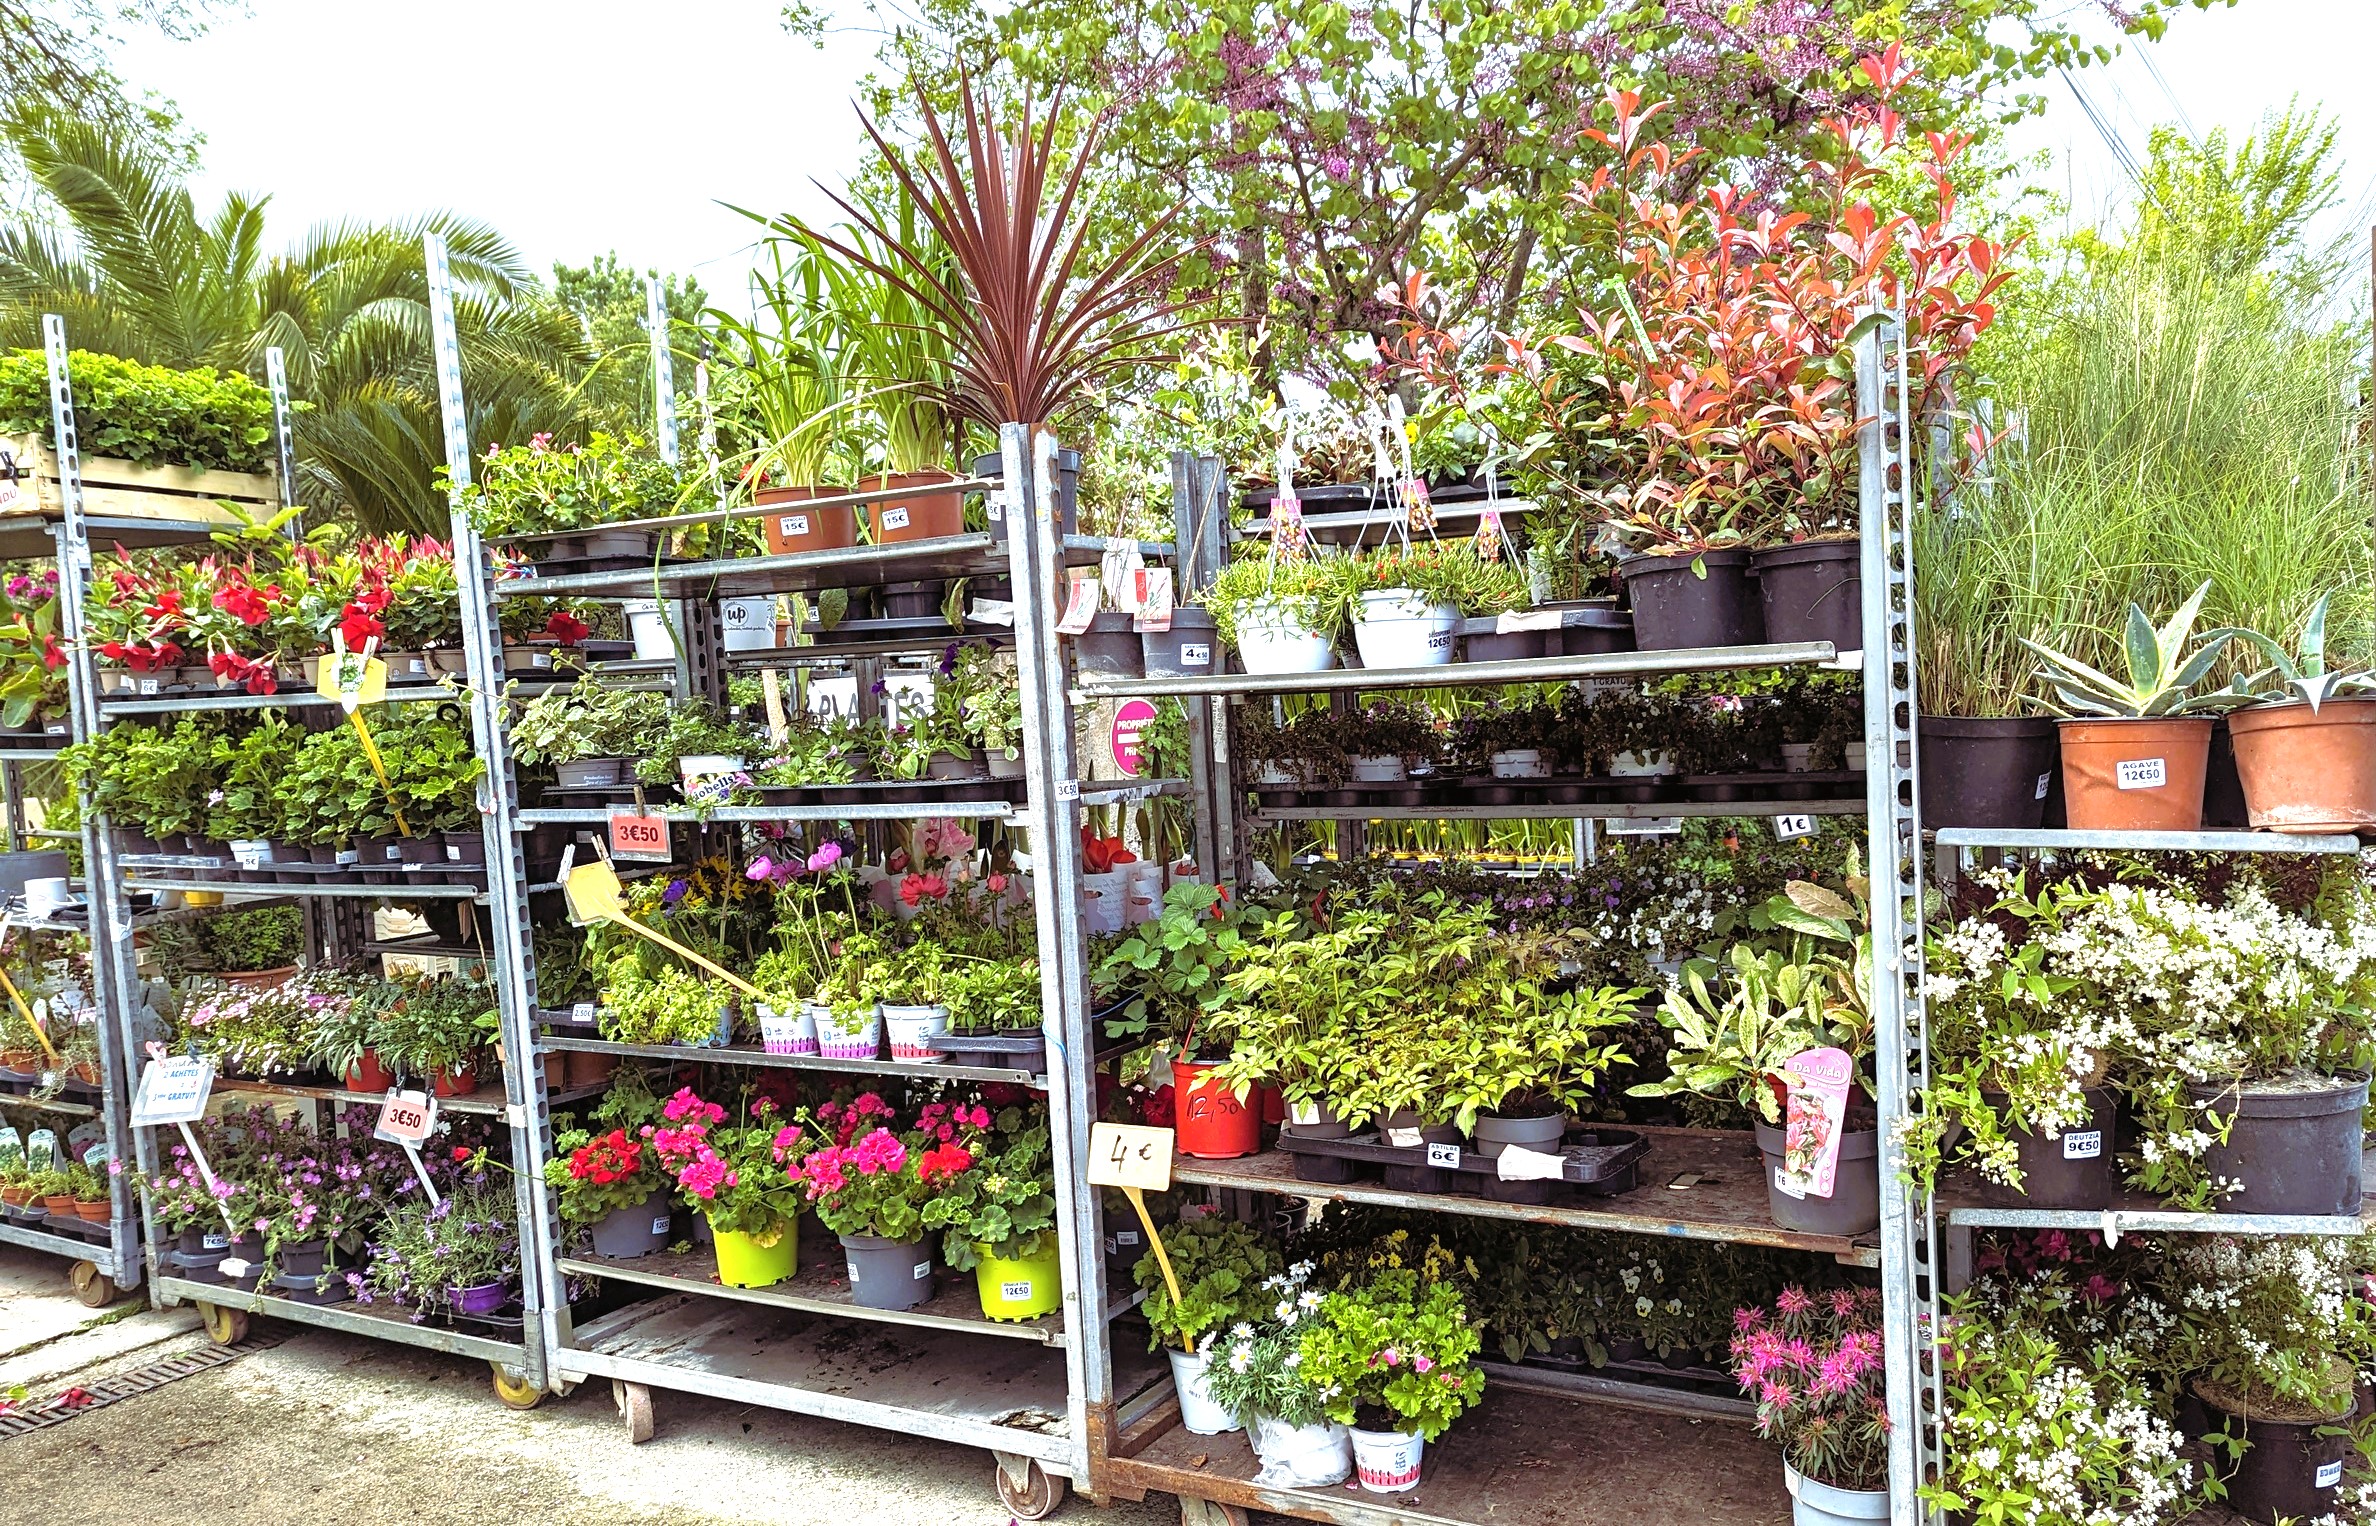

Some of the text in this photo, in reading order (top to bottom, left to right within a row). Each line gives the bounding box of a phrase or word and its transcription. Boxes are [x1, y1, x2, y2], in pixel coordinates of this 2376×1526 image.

[887, 514, 906, 524] 15€
[785, 522, 805, 531] 15€
[728, 607, 746, 623] up
[1428, 635, 1451, 648] 12€50
[2122, 760, 2160, 770] AGAVE
[2125, 769, 2160, 781] 12€50
[1058, 784, 1077, 796] 3€50
[620, 825, 659, 843] 3€50
[245, 858, 257, 866] 5€
[1793, 1061, 1842, 1079] Da Vida
[1187, 1095, 1239, 1123] 12,50
[389, 1108, 421, 1129] 3€50
[2068, 1132, 2100, 1141] DEUTZIA
[1431, 1144, 1458, 1152] ASTILBE
[2068, 1140, 2100, 1152] 9€50
[1432, 1150, 1455, 1162] 6€
[1005, 1286, 1029, 1296] 12€50
